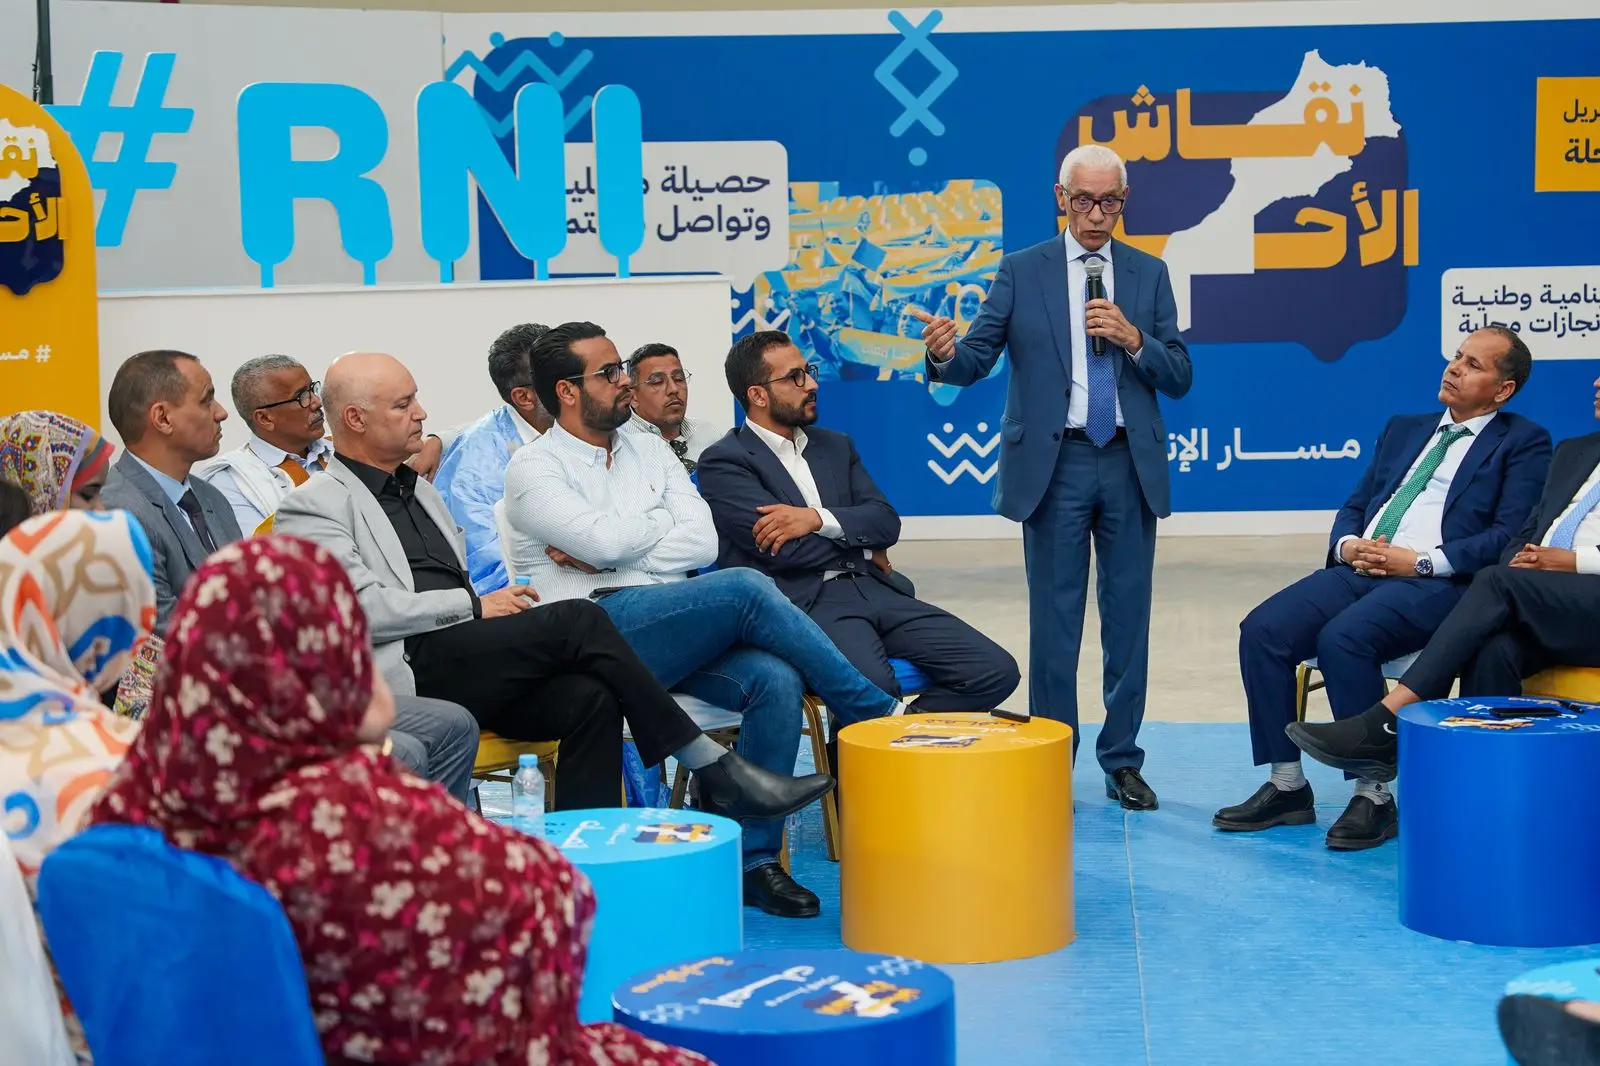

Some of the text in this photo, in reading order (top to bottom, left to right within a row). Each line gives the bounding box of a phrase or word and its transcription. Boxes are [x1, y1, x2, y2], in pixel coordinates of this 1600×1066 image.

[0, 135, 38, 179] نق
[660, 165, 771, 201] حصيلة
[656, 204, 772, 242] وتواصل
[1451, 283, 1600, 312] نامية وطنية
[1216, 427, 1361, 471] مسار
